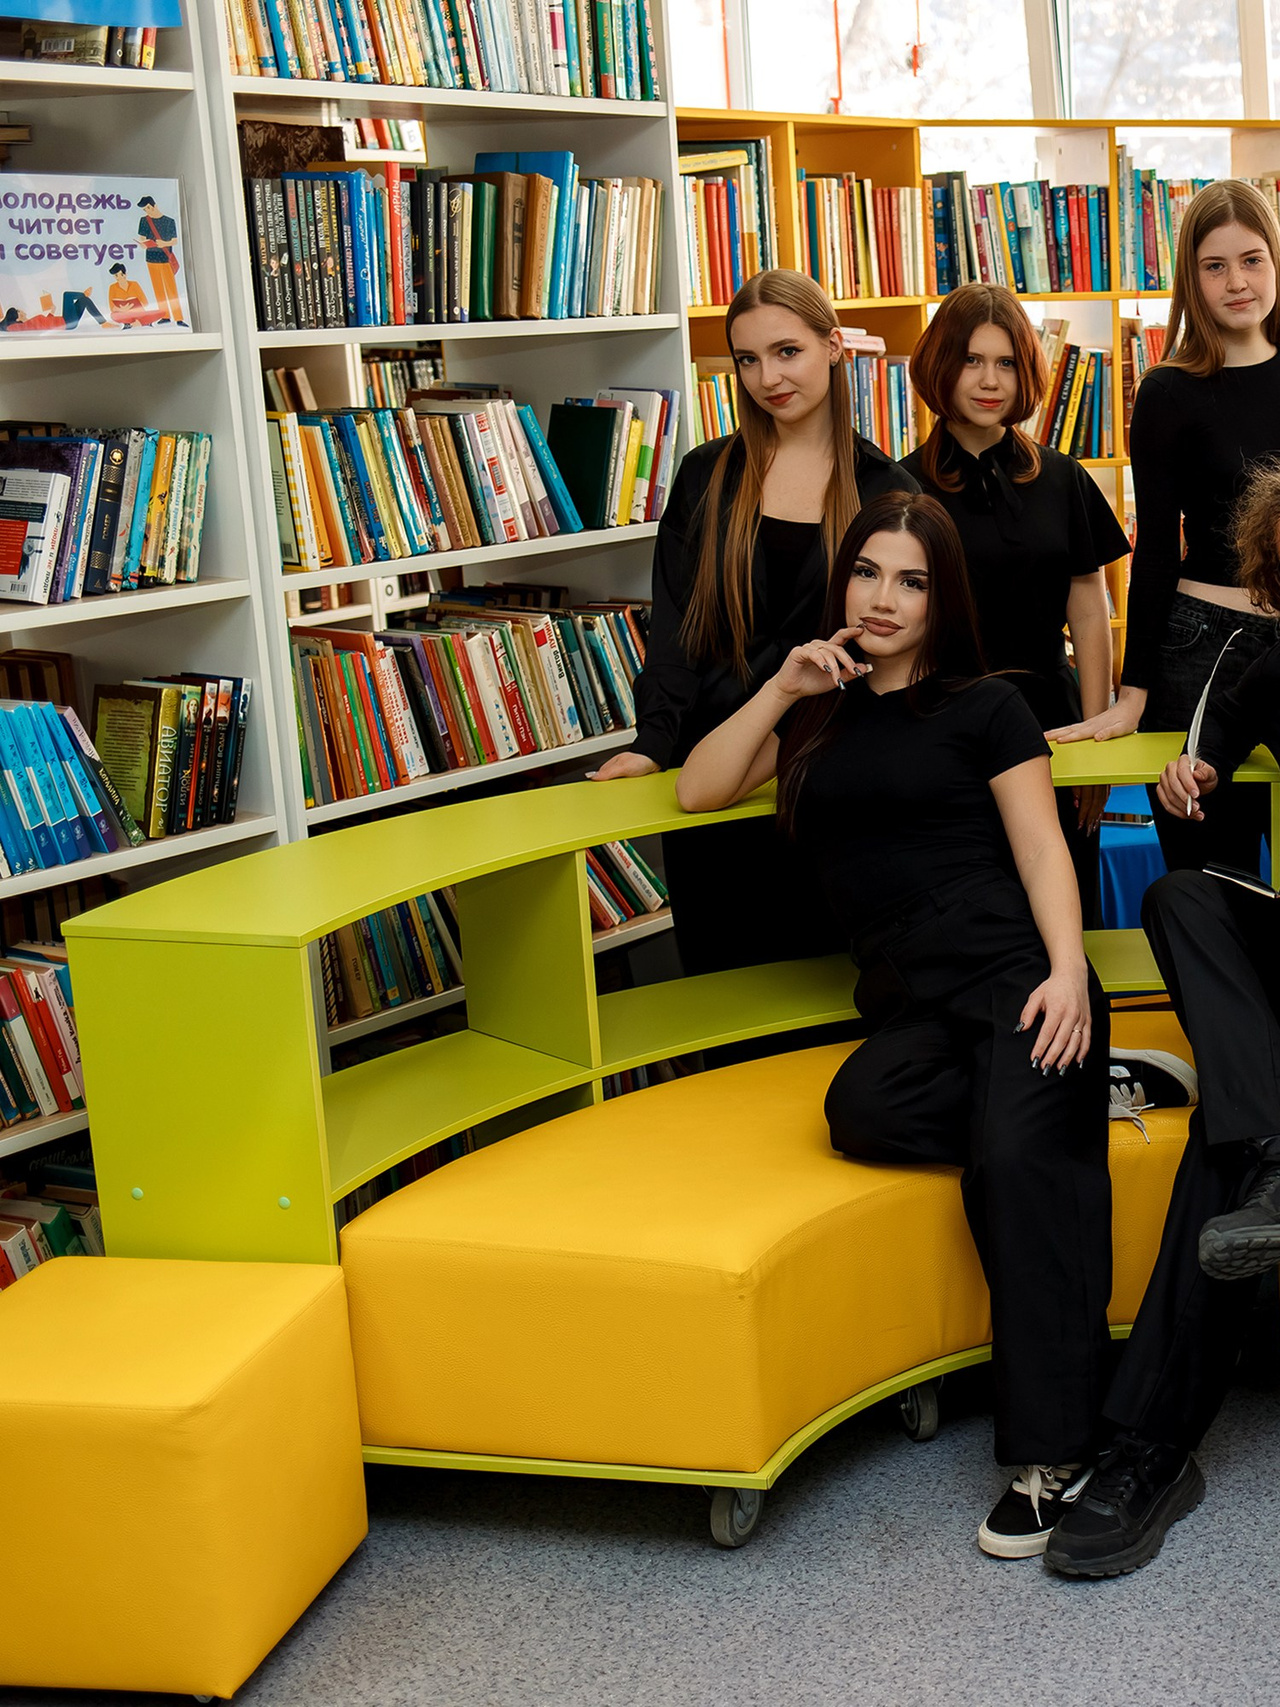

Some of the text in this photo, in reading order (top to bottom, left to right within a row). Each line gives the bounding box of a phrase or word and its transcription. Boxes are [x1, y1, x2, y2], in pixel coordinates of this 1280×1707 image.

[0, 192, 131, 214] олодежь
[8, 218, 105, 235] читает
[15, 243, 138, 266] советует
[1061, 353, 1076, 400] СЕМЬ ОГНЕЙ
[101, 513, 111, 539] ГОМЕР
[543, 621, 556, 648] ЛУНИН
[550, 649, 565, 678] Виктор
[511, 703, 527, 741] ПИТЕР ПЭН
[216, 731, 225, 757] ВОДЫ
[153, 725, 176, 812] АВИАТОР
[97, 767, 121, 806] КОРАЛИНА
[178, 769, 188, 805] ИЗЛОМ
[349, 957, 363, 981] ГОМЕР
